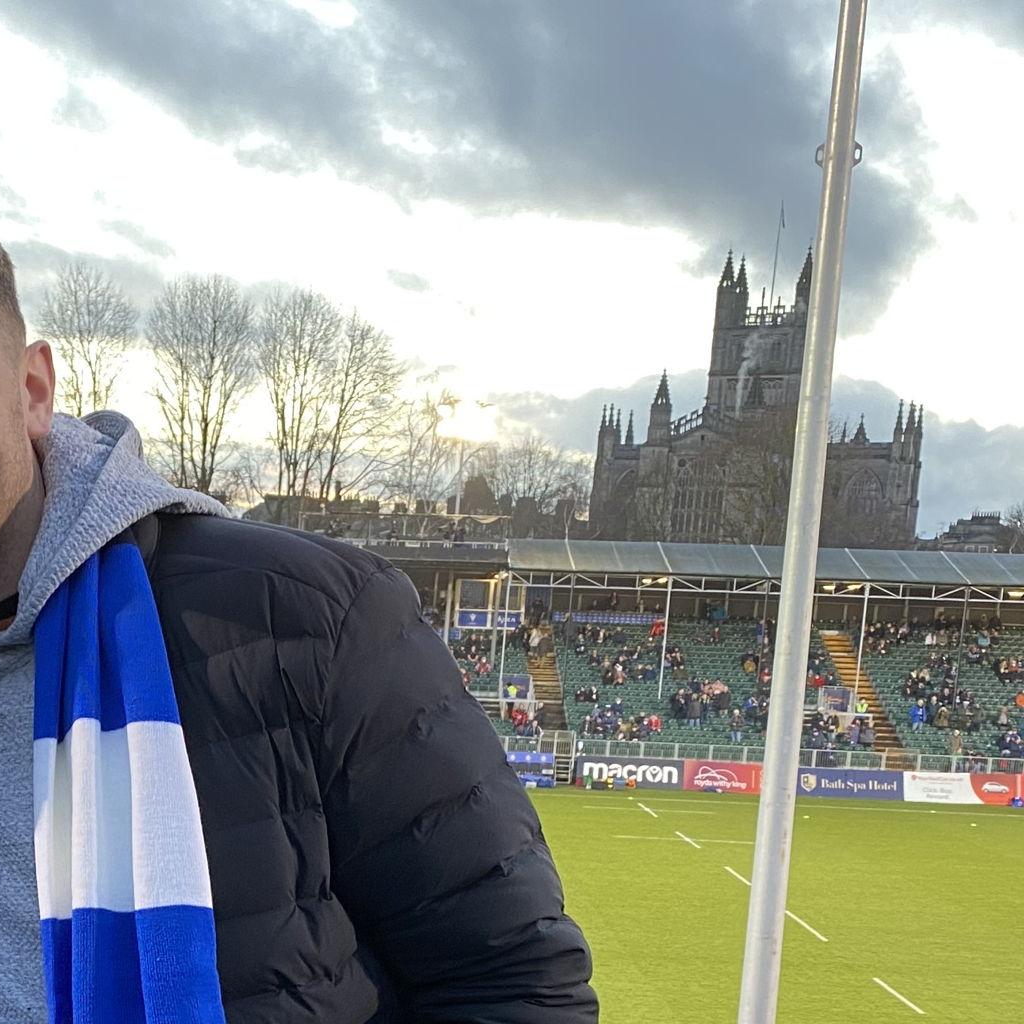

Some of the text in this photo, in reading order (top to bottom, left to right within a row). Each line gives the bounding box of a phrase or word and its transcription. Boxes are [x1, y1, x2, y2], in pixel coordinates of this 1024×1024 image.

[582, 762, 679, 784] macron
[821, 778, 897, 792] Bath Spa Hotel
